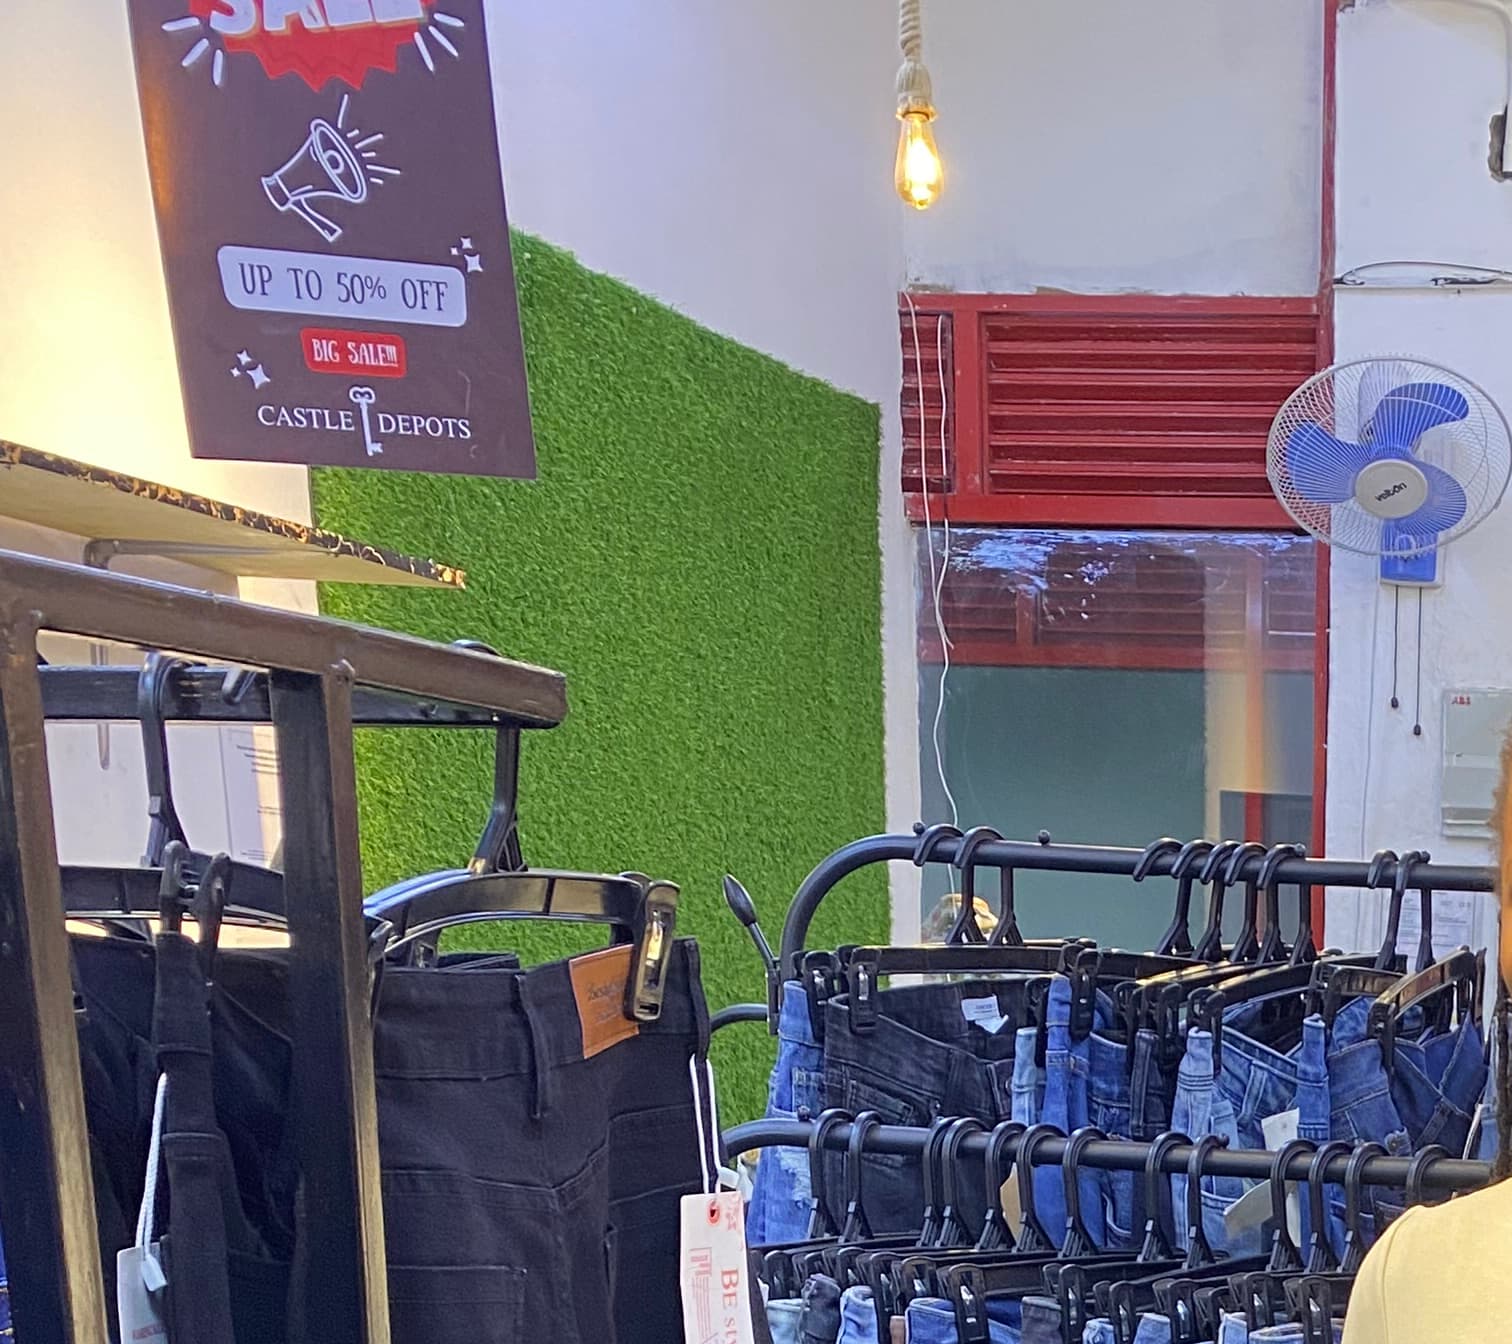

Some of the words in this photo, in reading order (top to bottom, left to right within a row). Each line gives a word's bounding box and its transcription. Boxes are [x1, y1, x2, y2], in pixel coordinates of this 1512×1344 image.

[239, 262, 273, 296] UP
[287, 267, 322, 301] TO
[336, 272, 387, 305] 50%
[401, 278, 448, 312] OFF
[311, 338, 340, 364] BIG
[257, 404, 356, 432] CASTLE
[377, 413, 473, 440] DEPOTS
[720, 1268, 739, 1311] BE
